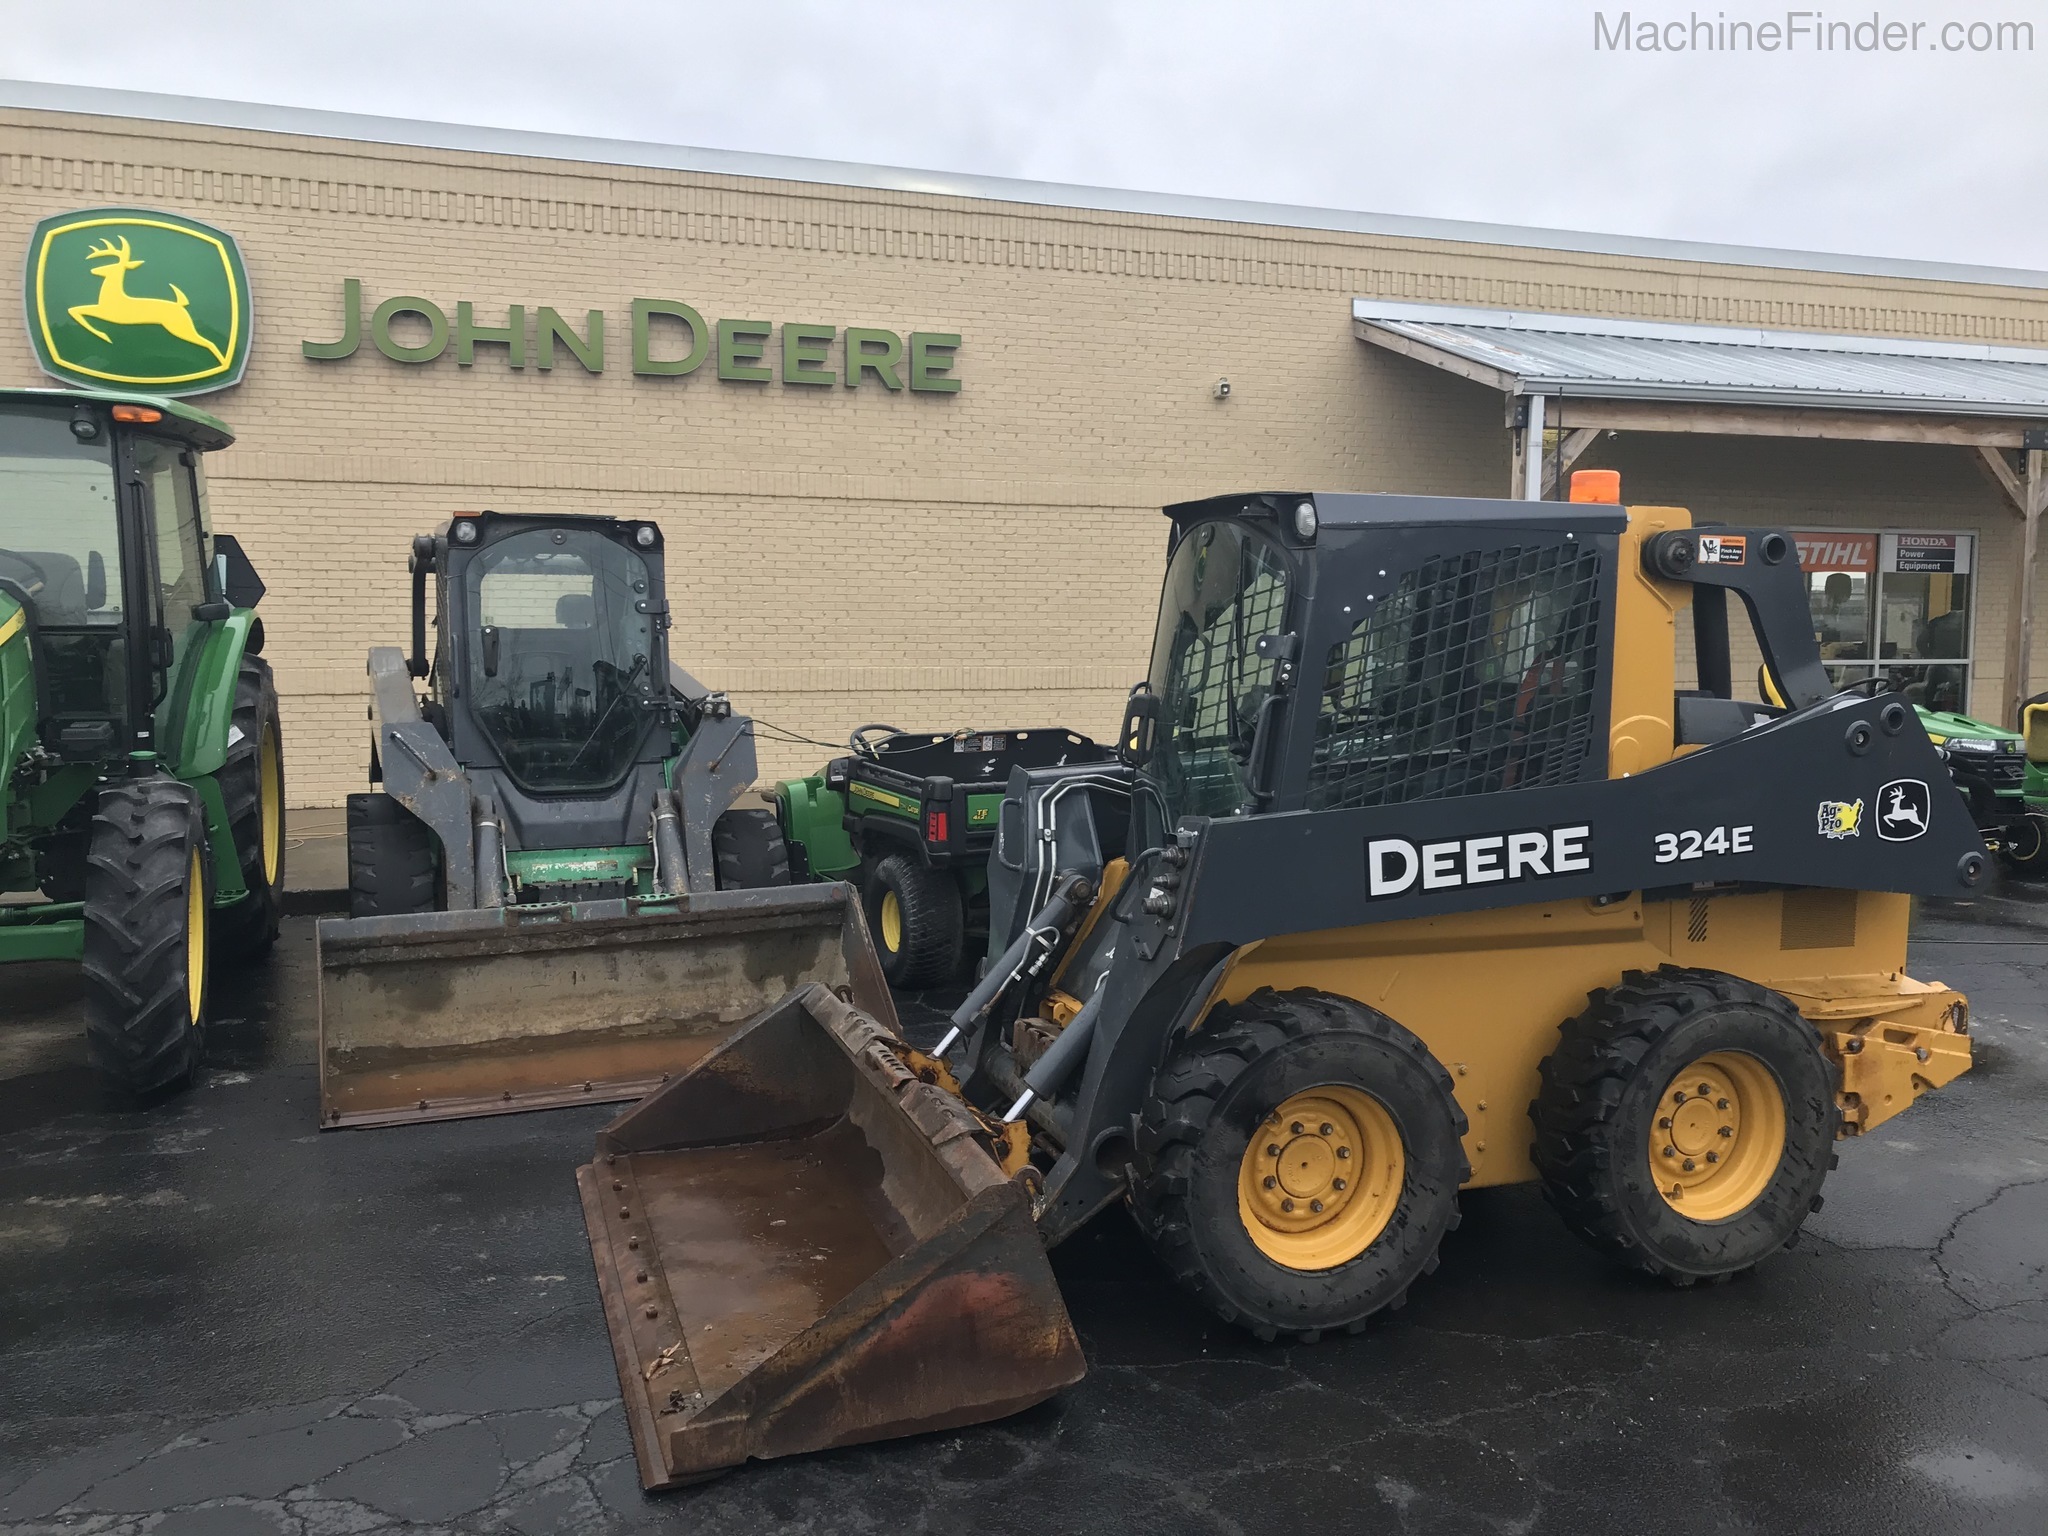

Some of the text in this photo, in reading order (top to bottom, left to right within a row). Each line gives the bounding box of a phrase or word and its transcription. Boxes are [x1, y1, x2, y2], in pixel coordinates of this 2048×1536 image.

[302, 278, 962, 393] JOHN DEERE
[1900, 537, 1948, 546] HONDA
[1795, 541, 1868, 565] STIHL
[1900, 550, 1925, 558] Power
[1899, 561, 1941, 571] Equipment
[1821, 817, 1842, 831] Pro
[1368, 825, 1754, 897] DEERE 324E
